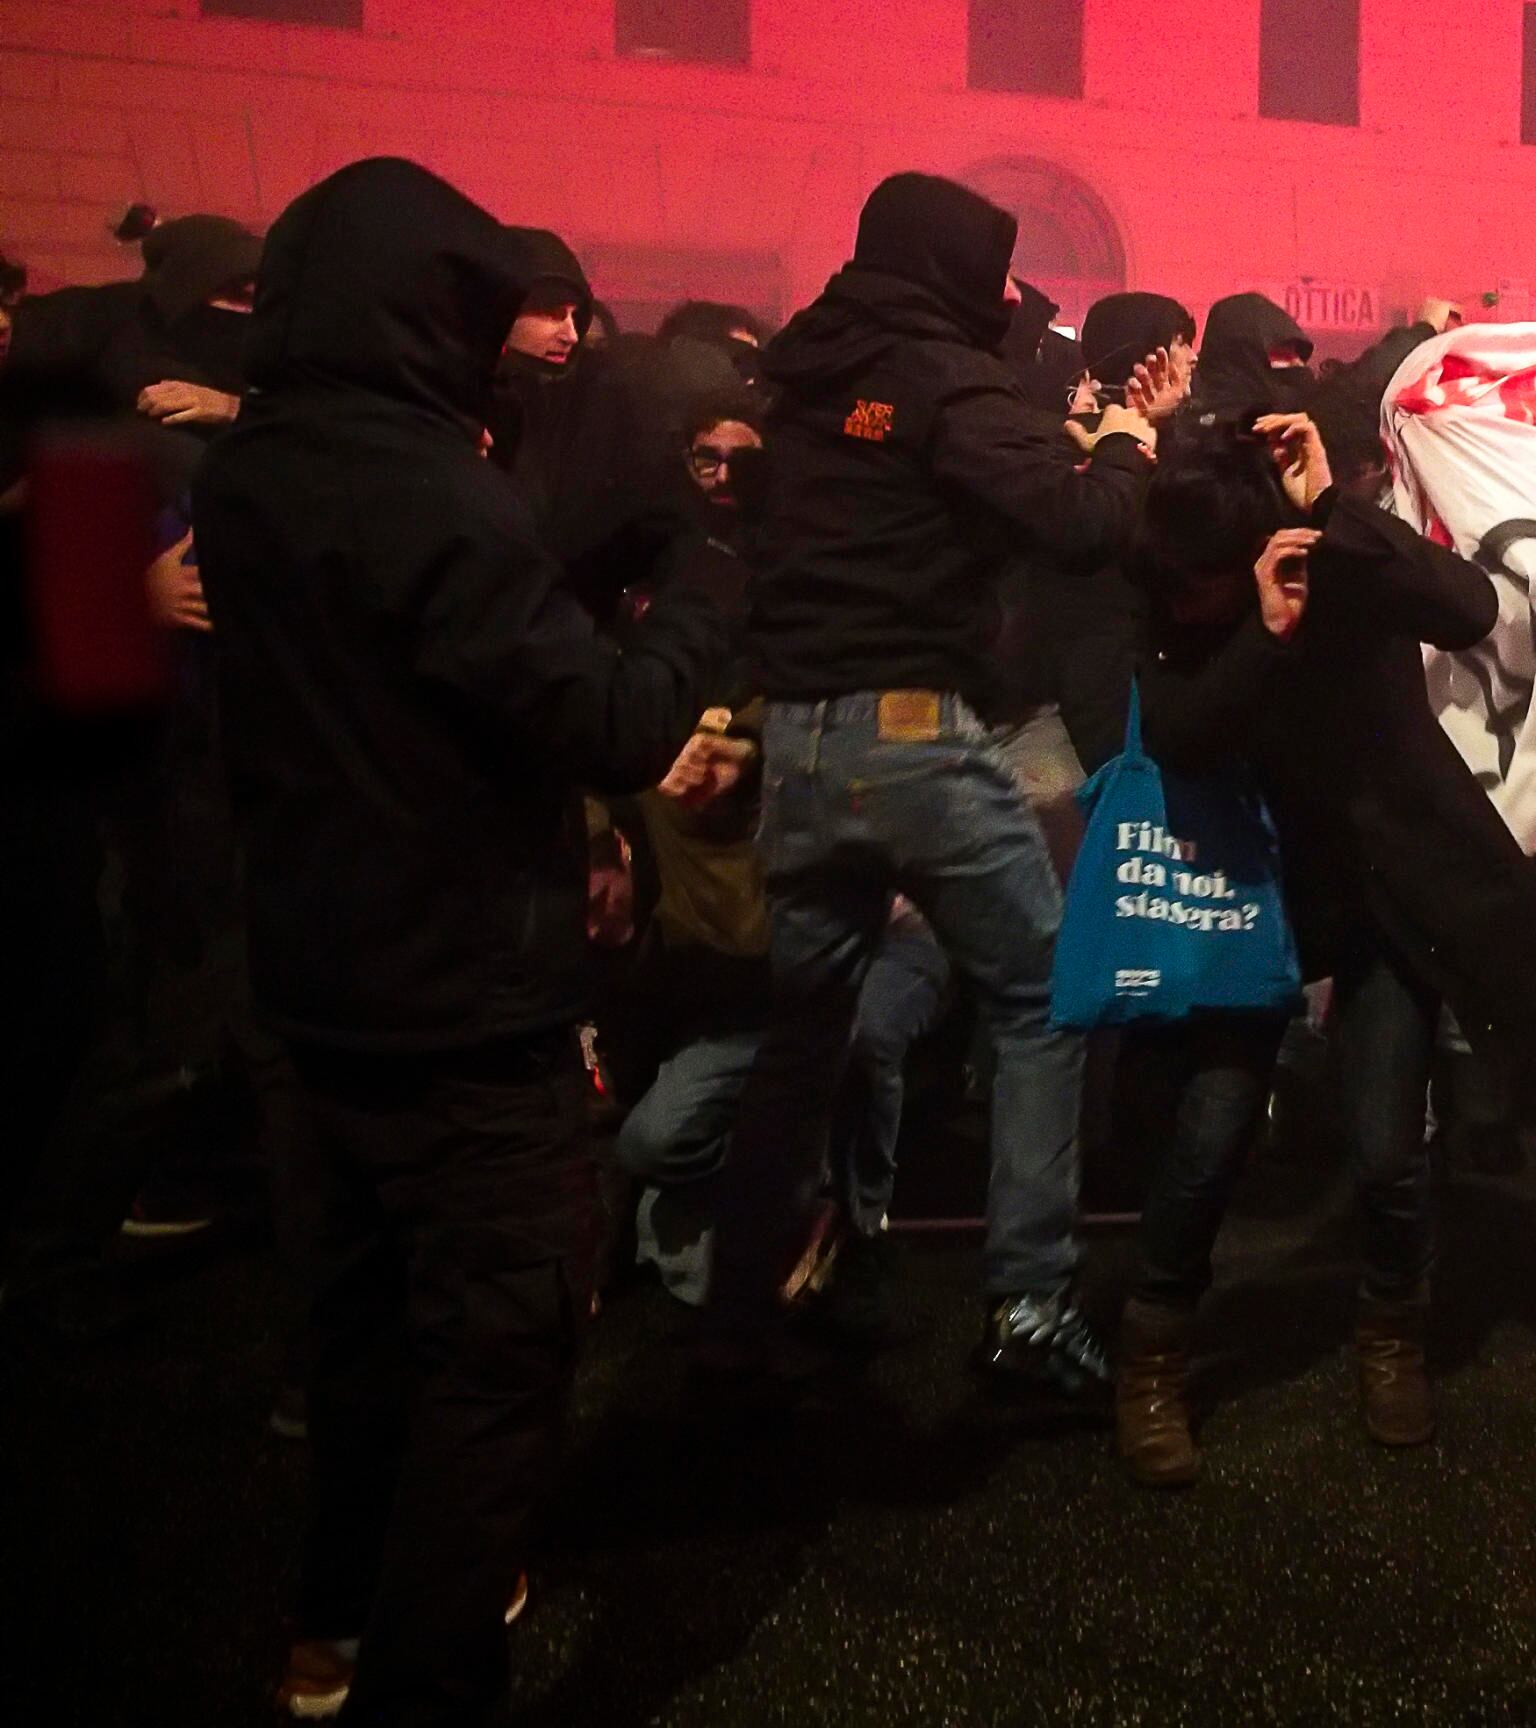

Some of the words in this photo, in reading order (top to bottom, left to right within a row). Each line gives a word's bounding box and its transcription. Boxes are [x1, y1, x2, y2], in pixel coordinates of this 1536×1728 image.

[1285, 286, 1373, 325] OTTICA
[1116, 856, 1168, 887] da
[1115, 891, 1261, 932] stasera?
